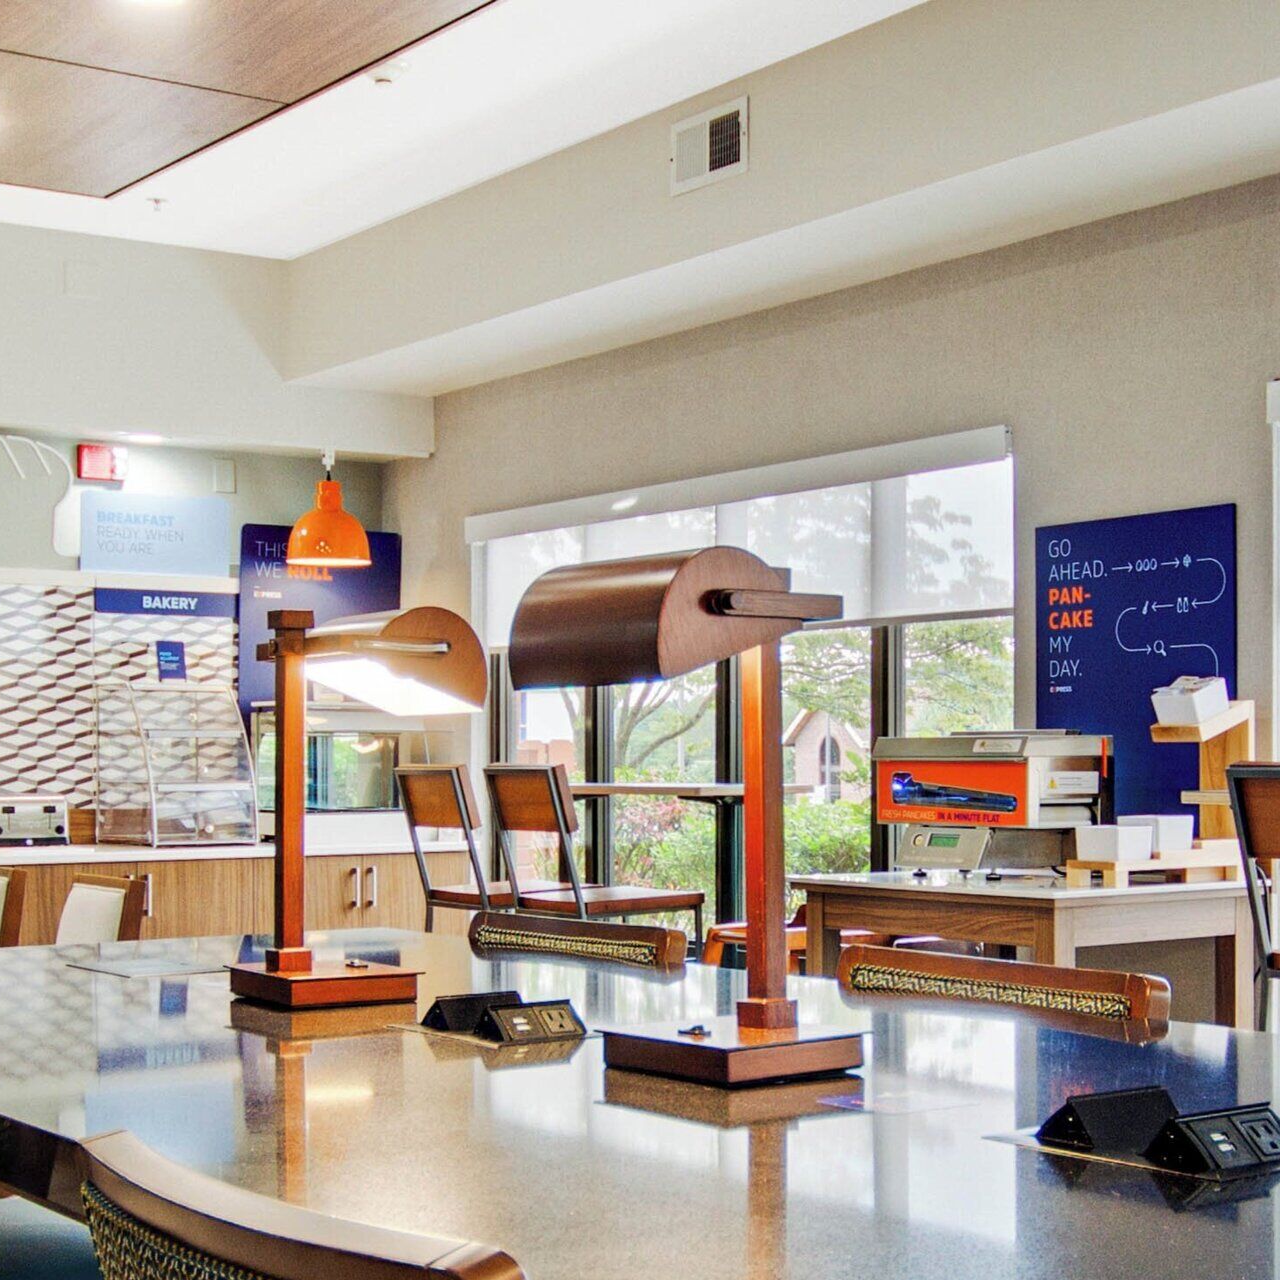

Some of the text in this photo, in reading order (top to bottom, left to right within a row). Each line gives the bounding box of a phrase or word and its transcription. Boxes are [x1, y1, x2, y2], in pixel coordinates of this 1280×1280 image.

[96, 511, 175, 526] BREAKFAST
[96, 525, 185, 542] READY WHEN
[96, 540, 154, 555] YOU ARE
[1048, 539, 1071, 558] GO
[255, 561, 282, 579] WE
[1048, 560, 1108, 582] AHEAD.
[142, 595, 198, 610] BAKERY
[1048, 586, 1092, 606] PAN-
[1048, 610, 1093, 630] CAKE
[1049, 636, 1073, 653] MY
[1049, 659, 1083, 678] DAY.
[937, 812, 946, 820] IN
[954, 813, 981, 822] MINUTE
[982, 814, 1001, 823] FLAT
